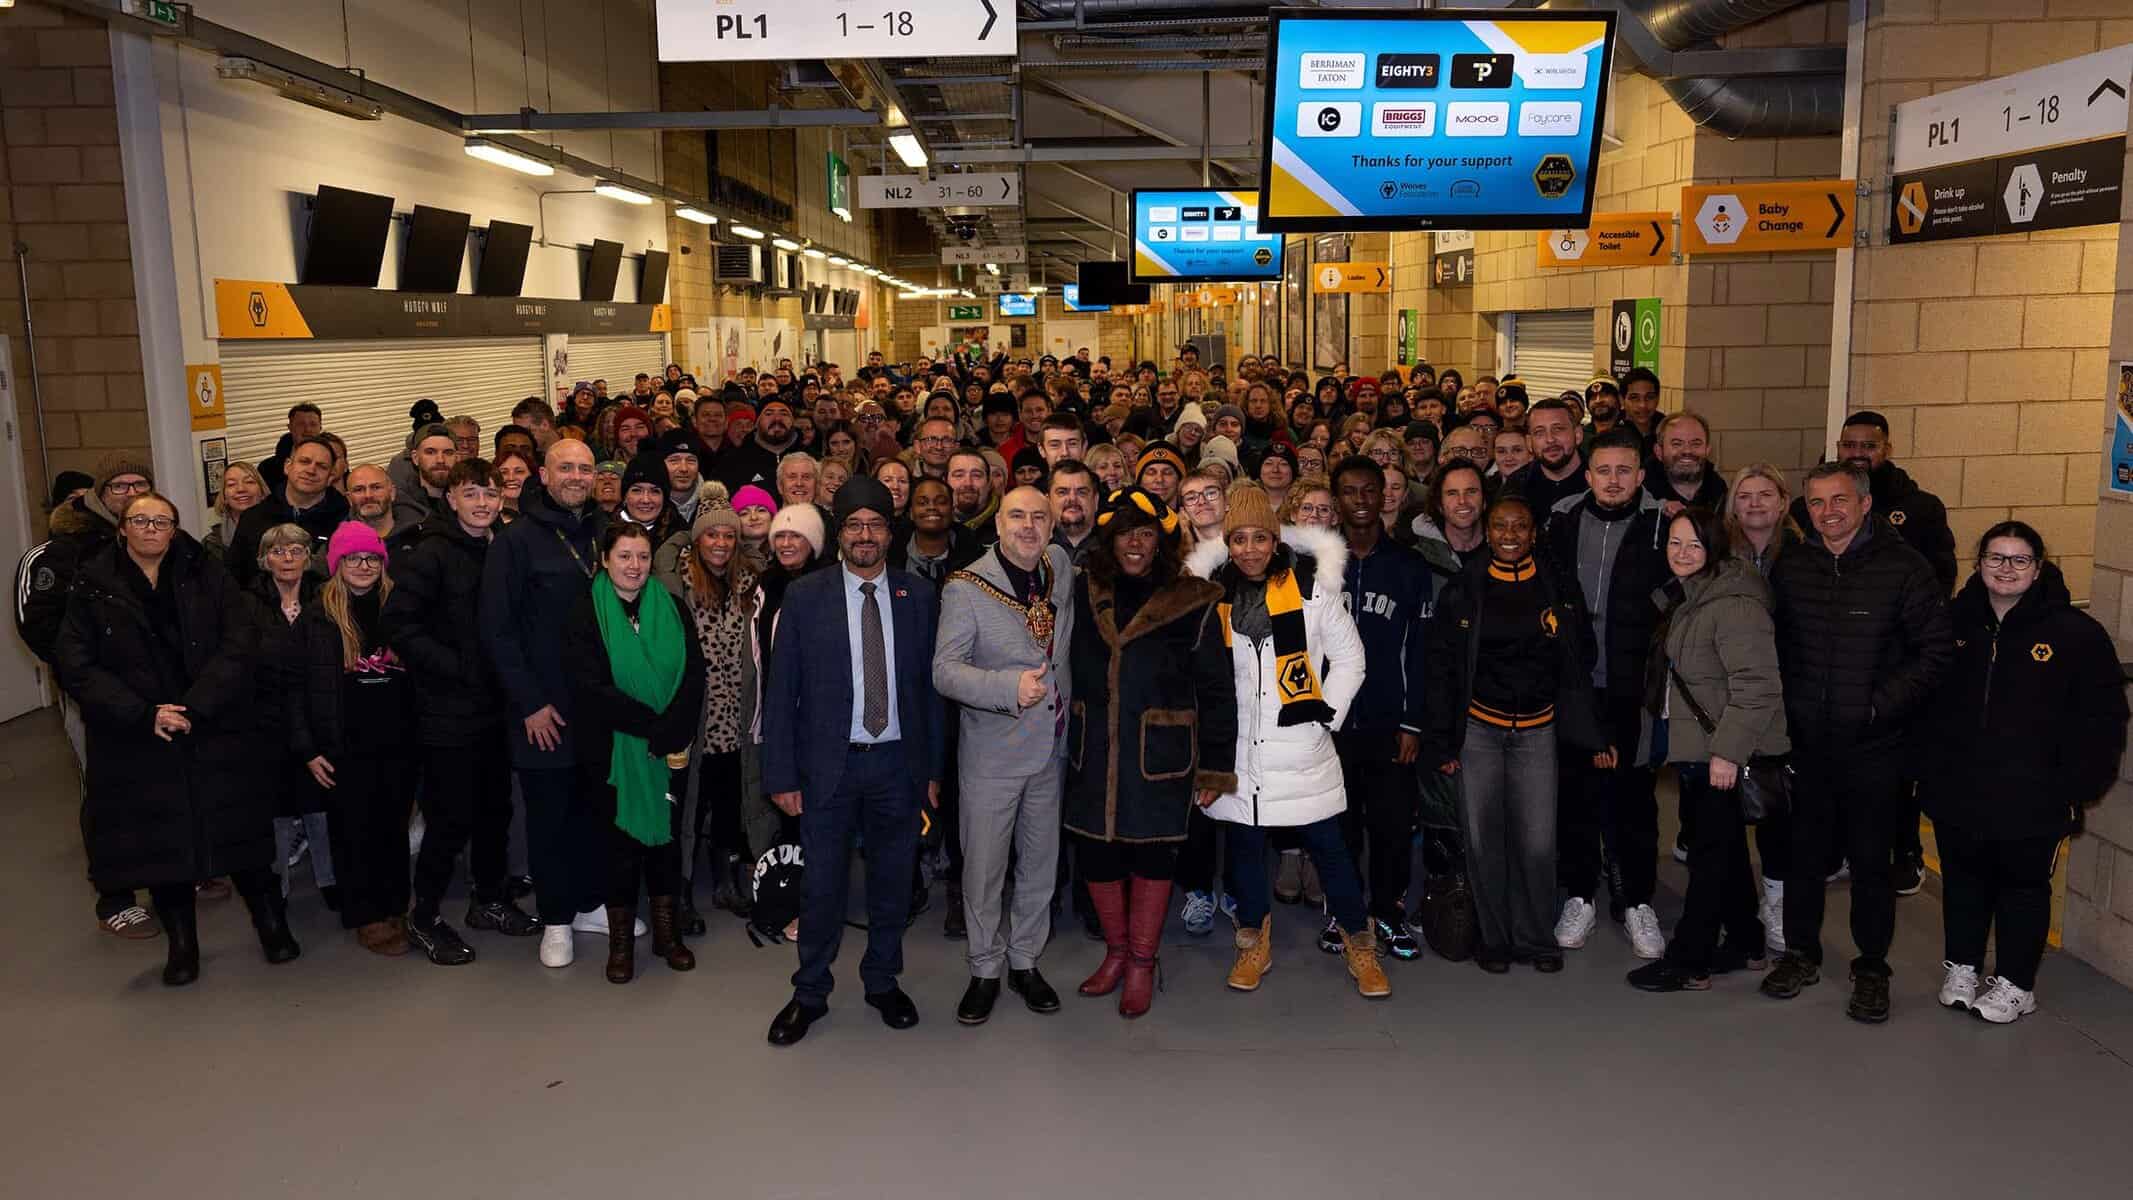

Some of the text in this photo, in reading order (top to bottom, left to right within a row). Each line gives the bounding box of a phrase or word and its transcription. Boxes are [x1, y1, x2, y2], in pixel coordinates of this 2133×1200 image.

[716, 13, 768, 39] PL1
[835, 12, 848, 37] 1
[882, 11, 914, 36] 18
[1310, 60, 1356, 68] BERRIMAN
[1318, 73, 1346, 82] EATON
[1381, 65, 1434, 77] EIGHTY3
[1385, 112, 1423, 121] BRIGGS
[1455, 115, 1499, 123] MOOG
[1928, 117, 1960, 148] PL1
[2002, 105, 2011, 132] 1
[2037, 95, 2060, 125] 18
[1352, 154, 1513, 170] Thanks for your support
[2051, 168, 2087, 184] Penalty
[885, 187, 912, 199] NL2
[938, 186, 950, 198] 31
[967, 185, 983, 197] 60
[1934, 187, 1965, 200] Drink up
[1758, 203, 1789, 217] Baby
[1758, 219, 1803, 233] Change
[1599, 230, 1641, 240] Accessible
[1599, 241, 1622, 251] Toilet
